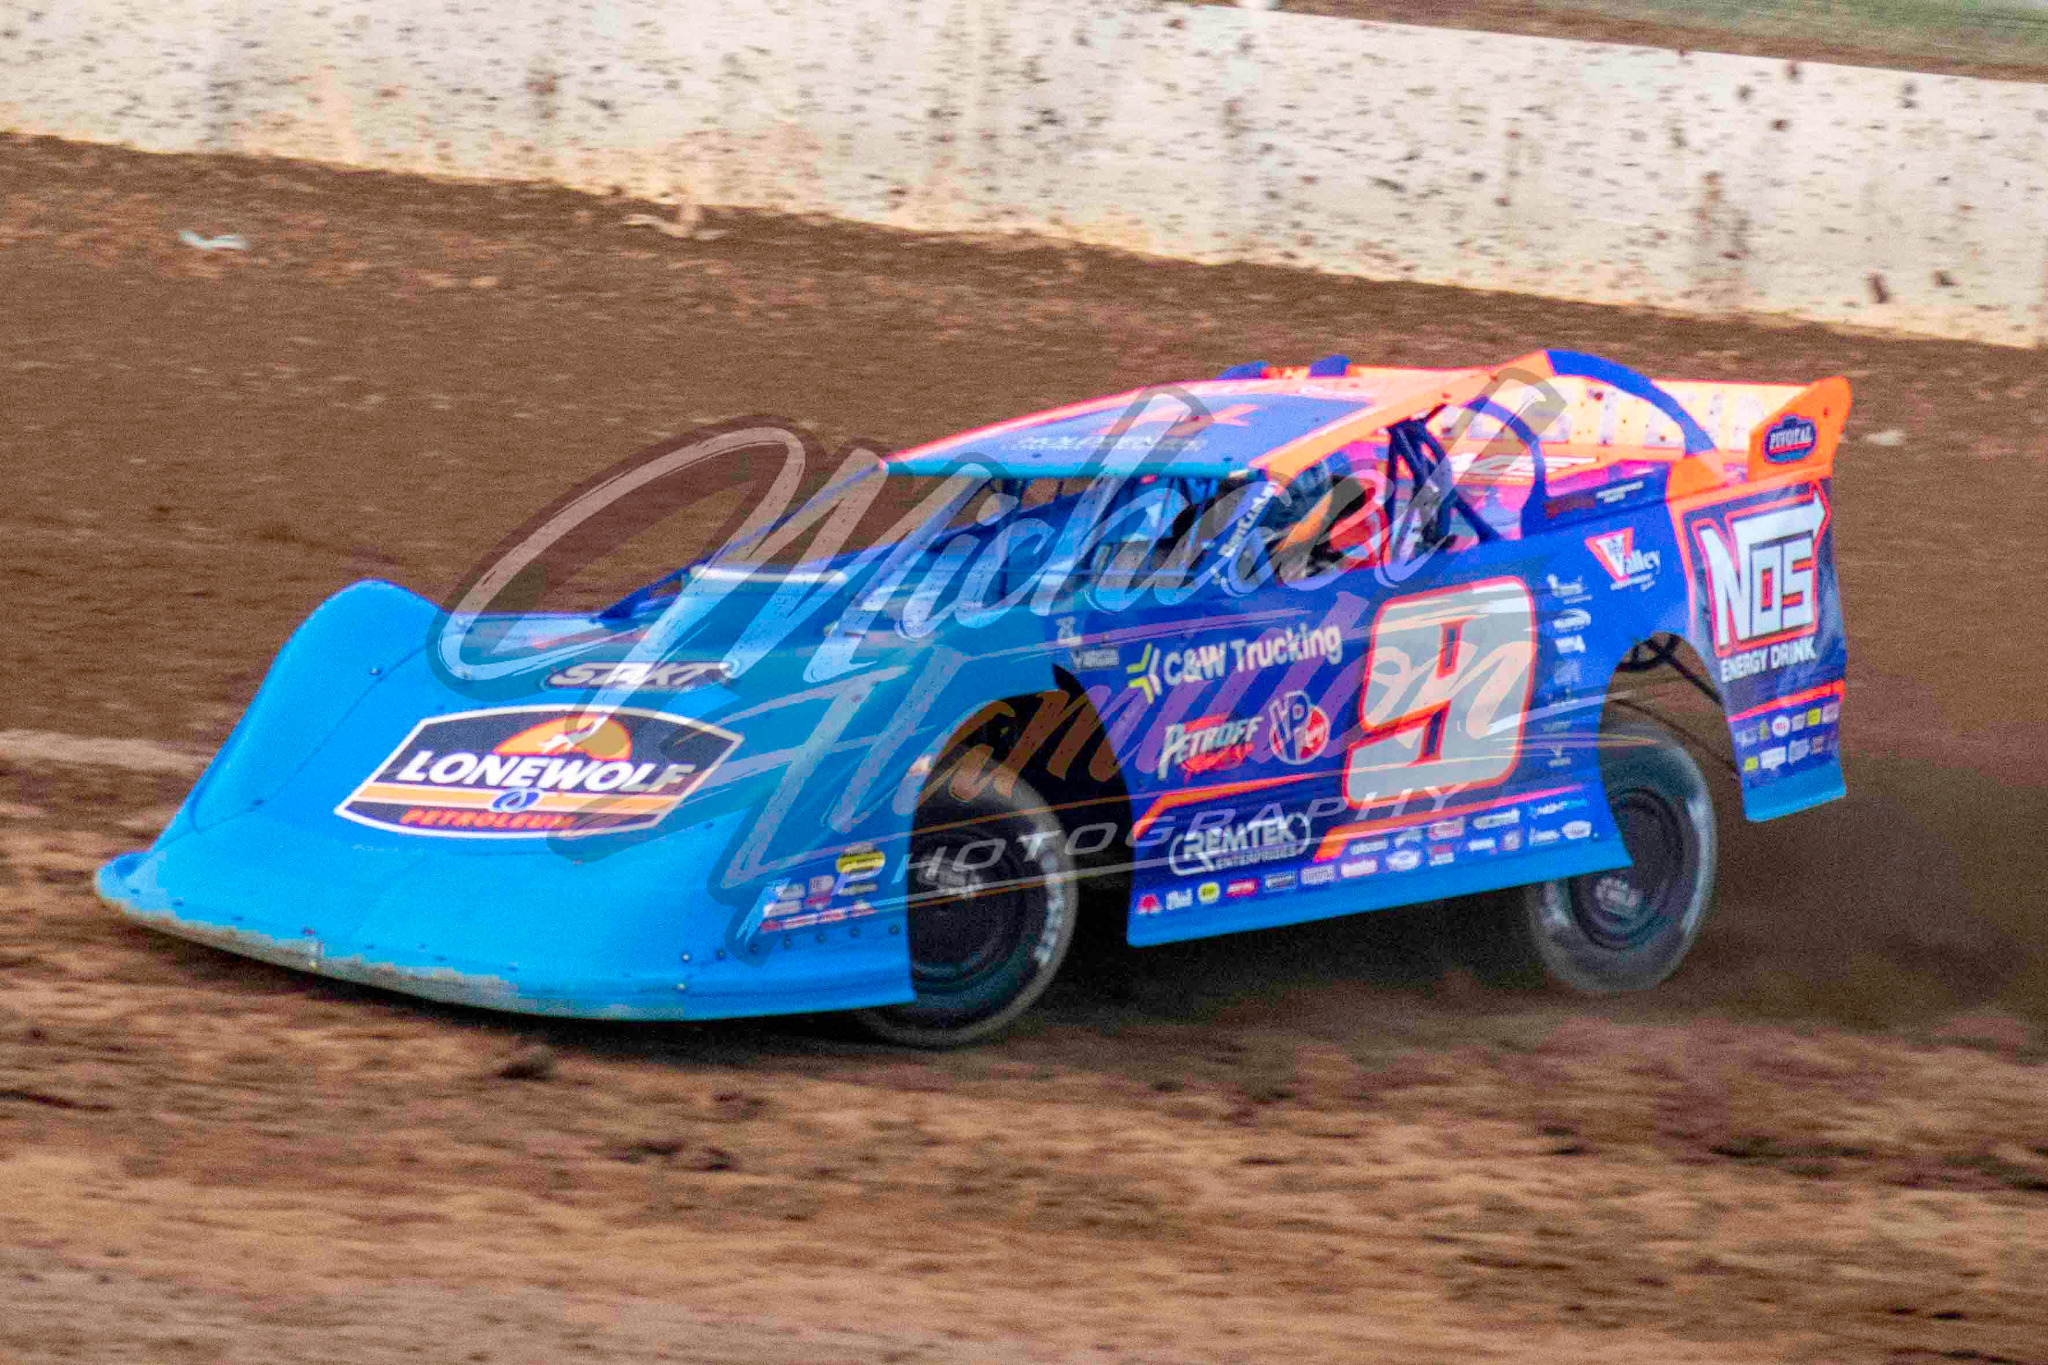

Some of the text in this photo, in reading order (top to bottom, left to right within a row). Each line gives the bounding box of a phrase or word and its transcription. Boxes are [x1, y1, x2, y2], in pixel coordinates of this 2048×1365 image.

[1699, 491, 1825, 648] NOS
[1163, 642, 1227, 685] C&W
[1230, 623, 1344, 673] Trucking
[1720, 636, 1816, 684] ENERGY DRINK
[1342, 575, 1537, 810] 9
[397, 750, 697, 793] LONEWOLF
[1157, 717, 1263, 780] PETROFF
[1183, 816, 1297, 872] REMTEK
